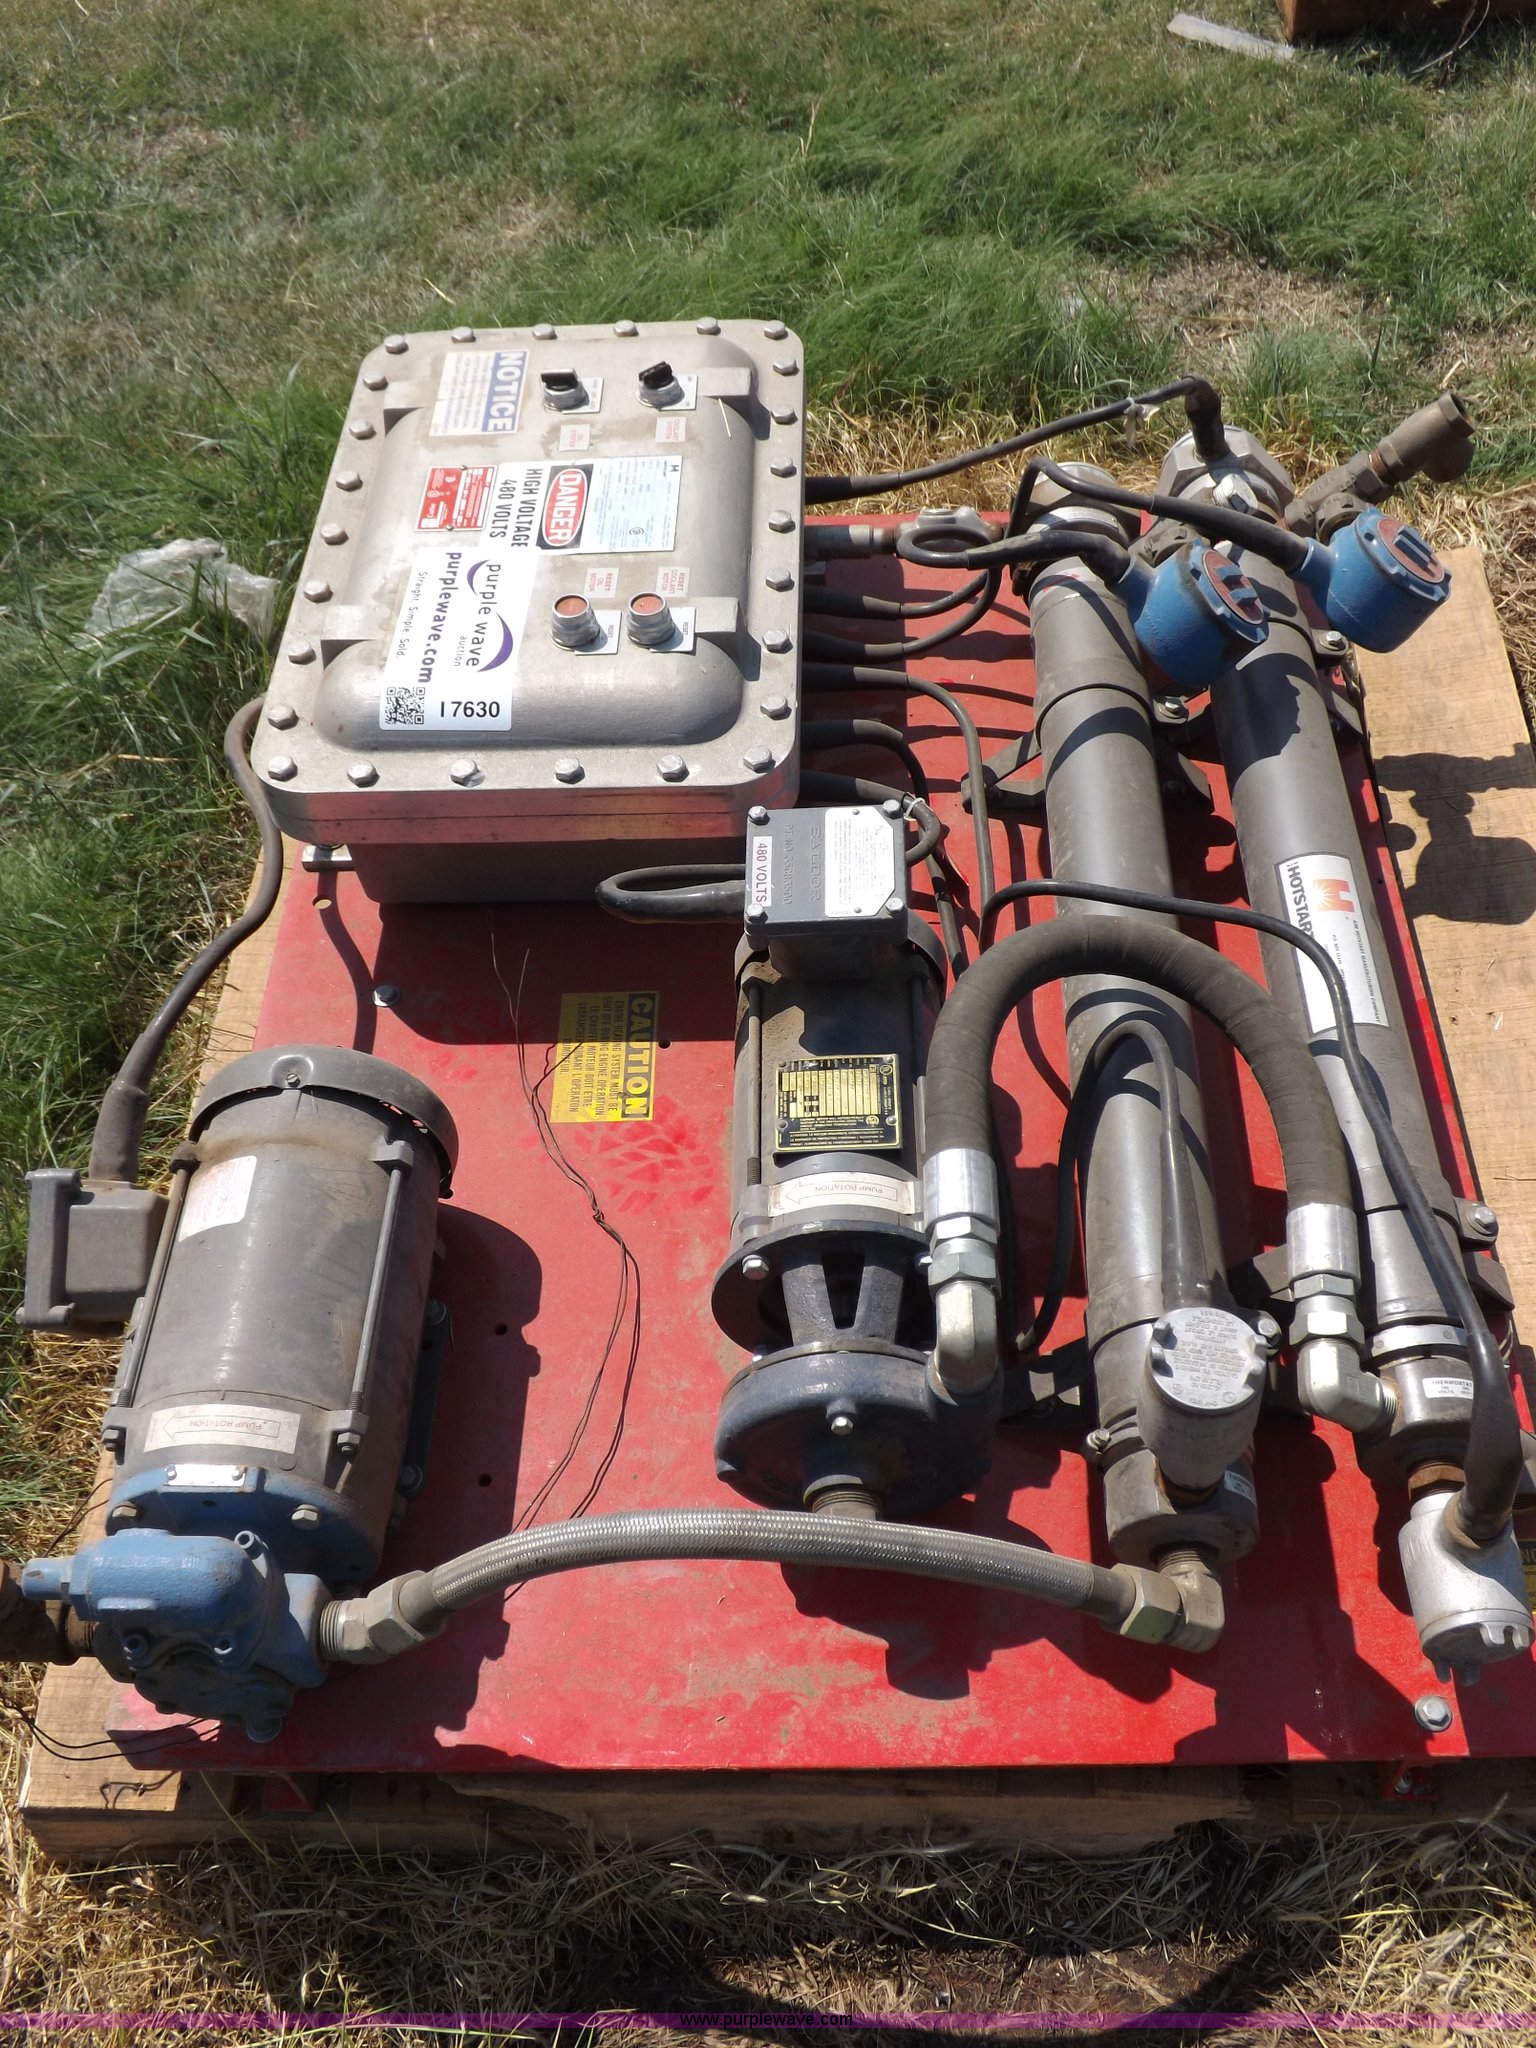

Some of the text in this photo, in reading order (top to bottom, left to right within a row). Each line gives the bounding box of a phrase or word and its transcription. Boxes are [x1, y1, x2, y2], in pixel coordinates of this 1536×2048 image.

[488, 352, 524, 431] NOTICE
[489, 479, 517, 538] 480 VOLTS
[511, 469, 543, 547] HIGH VOLTAGE
[548, 473, 581, 542] DANGER
[588, 572, 597, 593] MOTOR
[596, 578, 604, 587] OIL
[605, 572, 613, 592] RESET
[661, 572, 670, 592] MOTOR
[668, 569, 677, 595] COOLANT
[677, 572, 685, 591] RESET
[395, 572, 428, 658] Straight. Simple. Sold.
[418, 552, 463, 683] purplewave.com
[466, 564, 502, 667] purple wave
[454, 636, 467, 666] auction
[756, 843, 768, 902] 480 VOLTS
[810, 826, 822, 902] BALDOR
[612, 1026, 623, 1052] HEATING
[586, 1046, 596, 1072] MOTEUR
[598, 1054, 608, 1077] ENGINE
[609, 1054, 620, 1080] SYSTEM
[625, 997, 653, 1115] CAUTION
[584, 1074, 594, 1088] DOIT
[609, 1082, 619, 1101] MUST
[583, 1091, 592, 1107] ETRE
[594, 1080, 605, 1118] OPERATION.
[607, 1103, 617, 1111] BE
[190, 1418, 262, 1431] PUMP ROTATION
